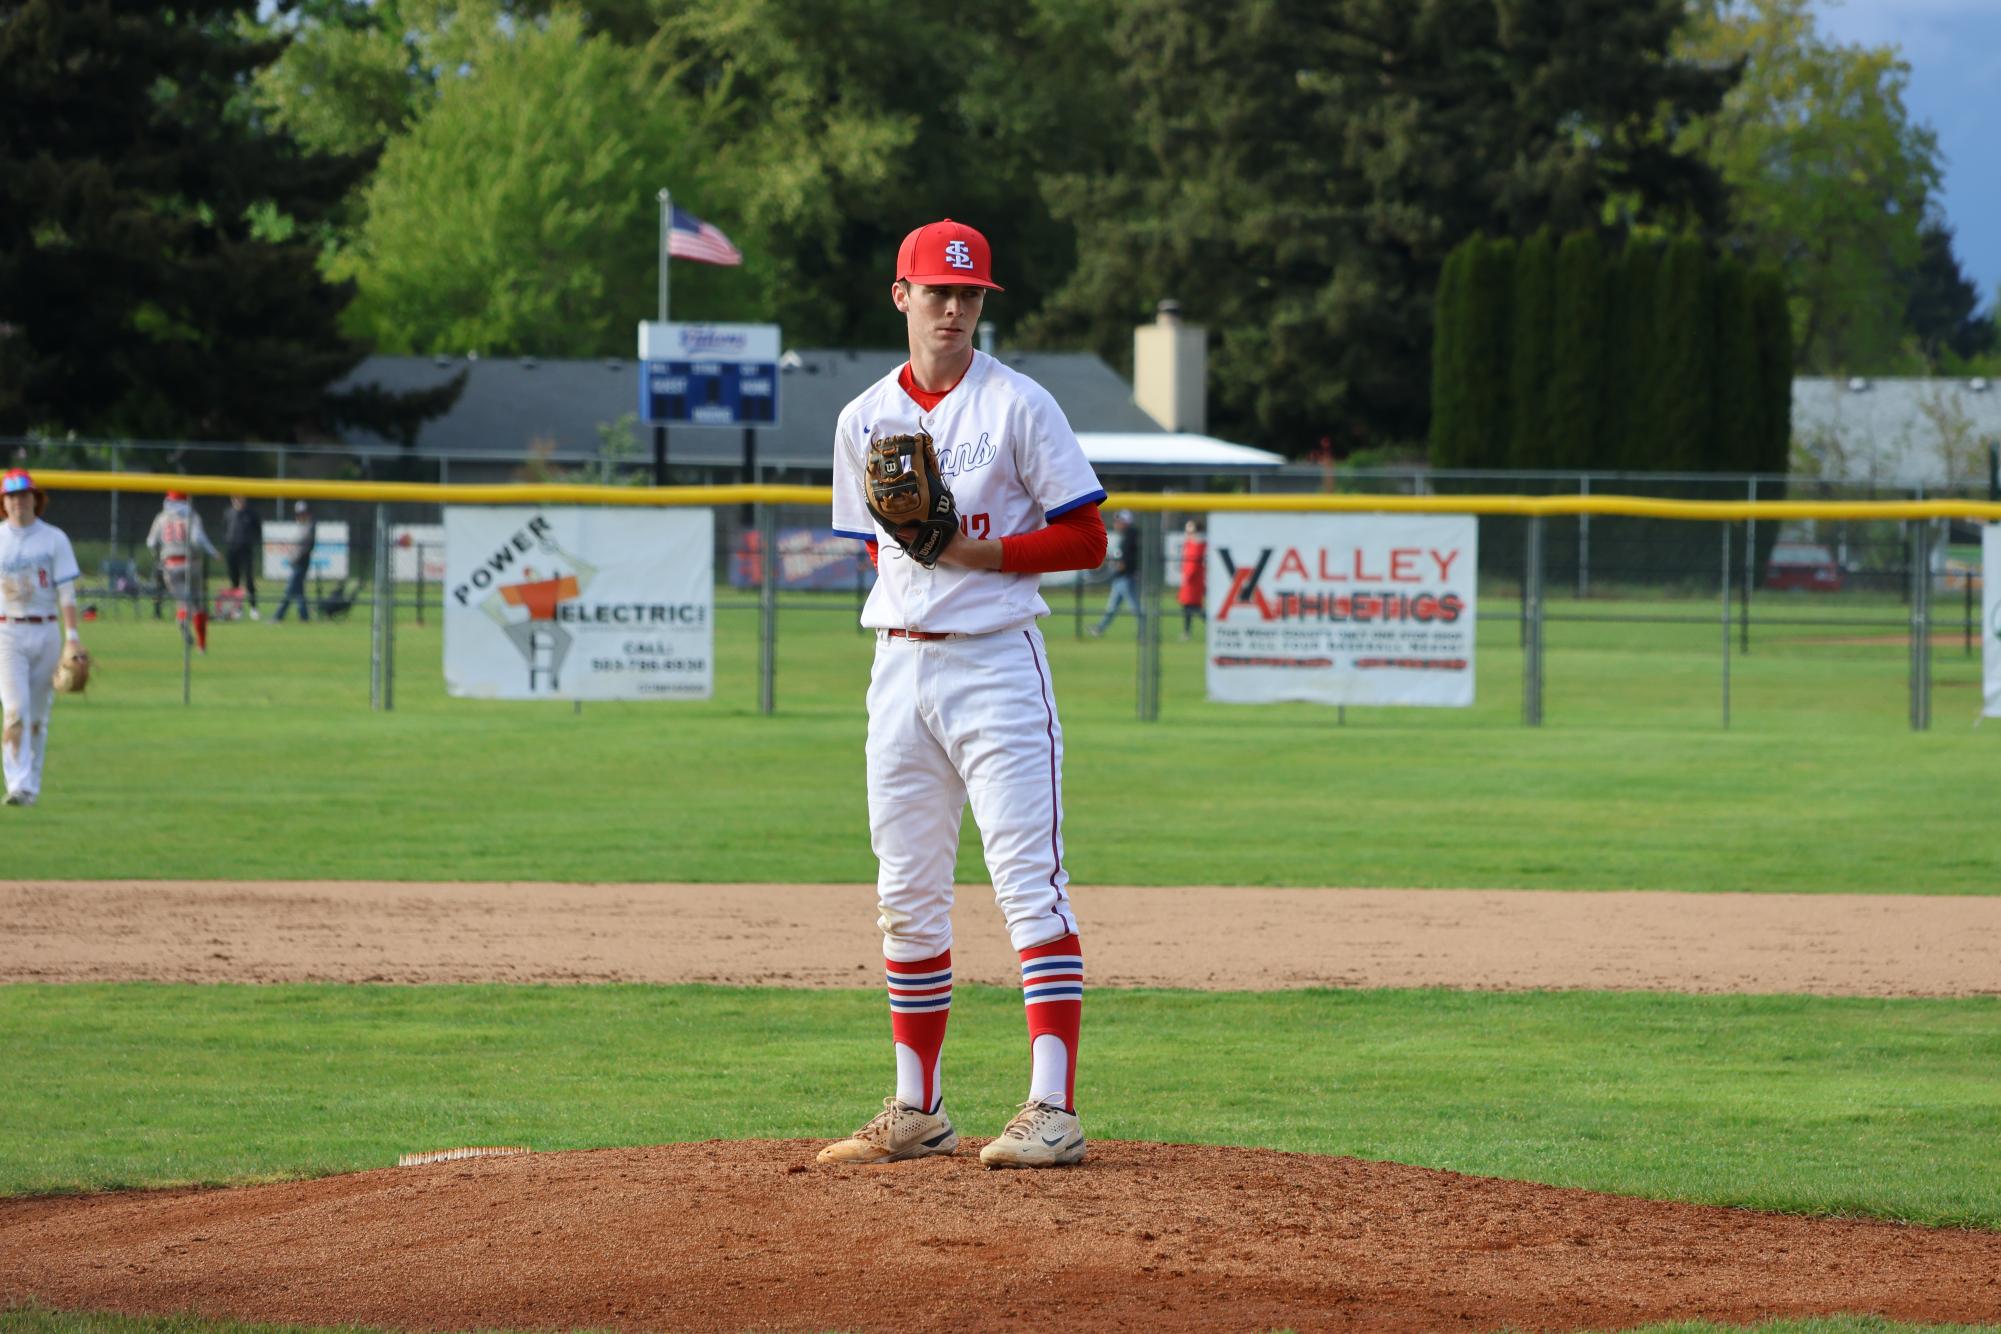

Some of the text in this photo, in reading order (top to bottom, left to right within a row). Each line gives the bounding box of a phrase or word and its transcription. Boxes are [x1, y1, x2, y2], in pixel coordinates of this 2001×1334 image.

[918, 528, 940, 556] Wilson
[453, 514, 552, 606] POWER
[561, 604, 696, 623] ELECTRIC
